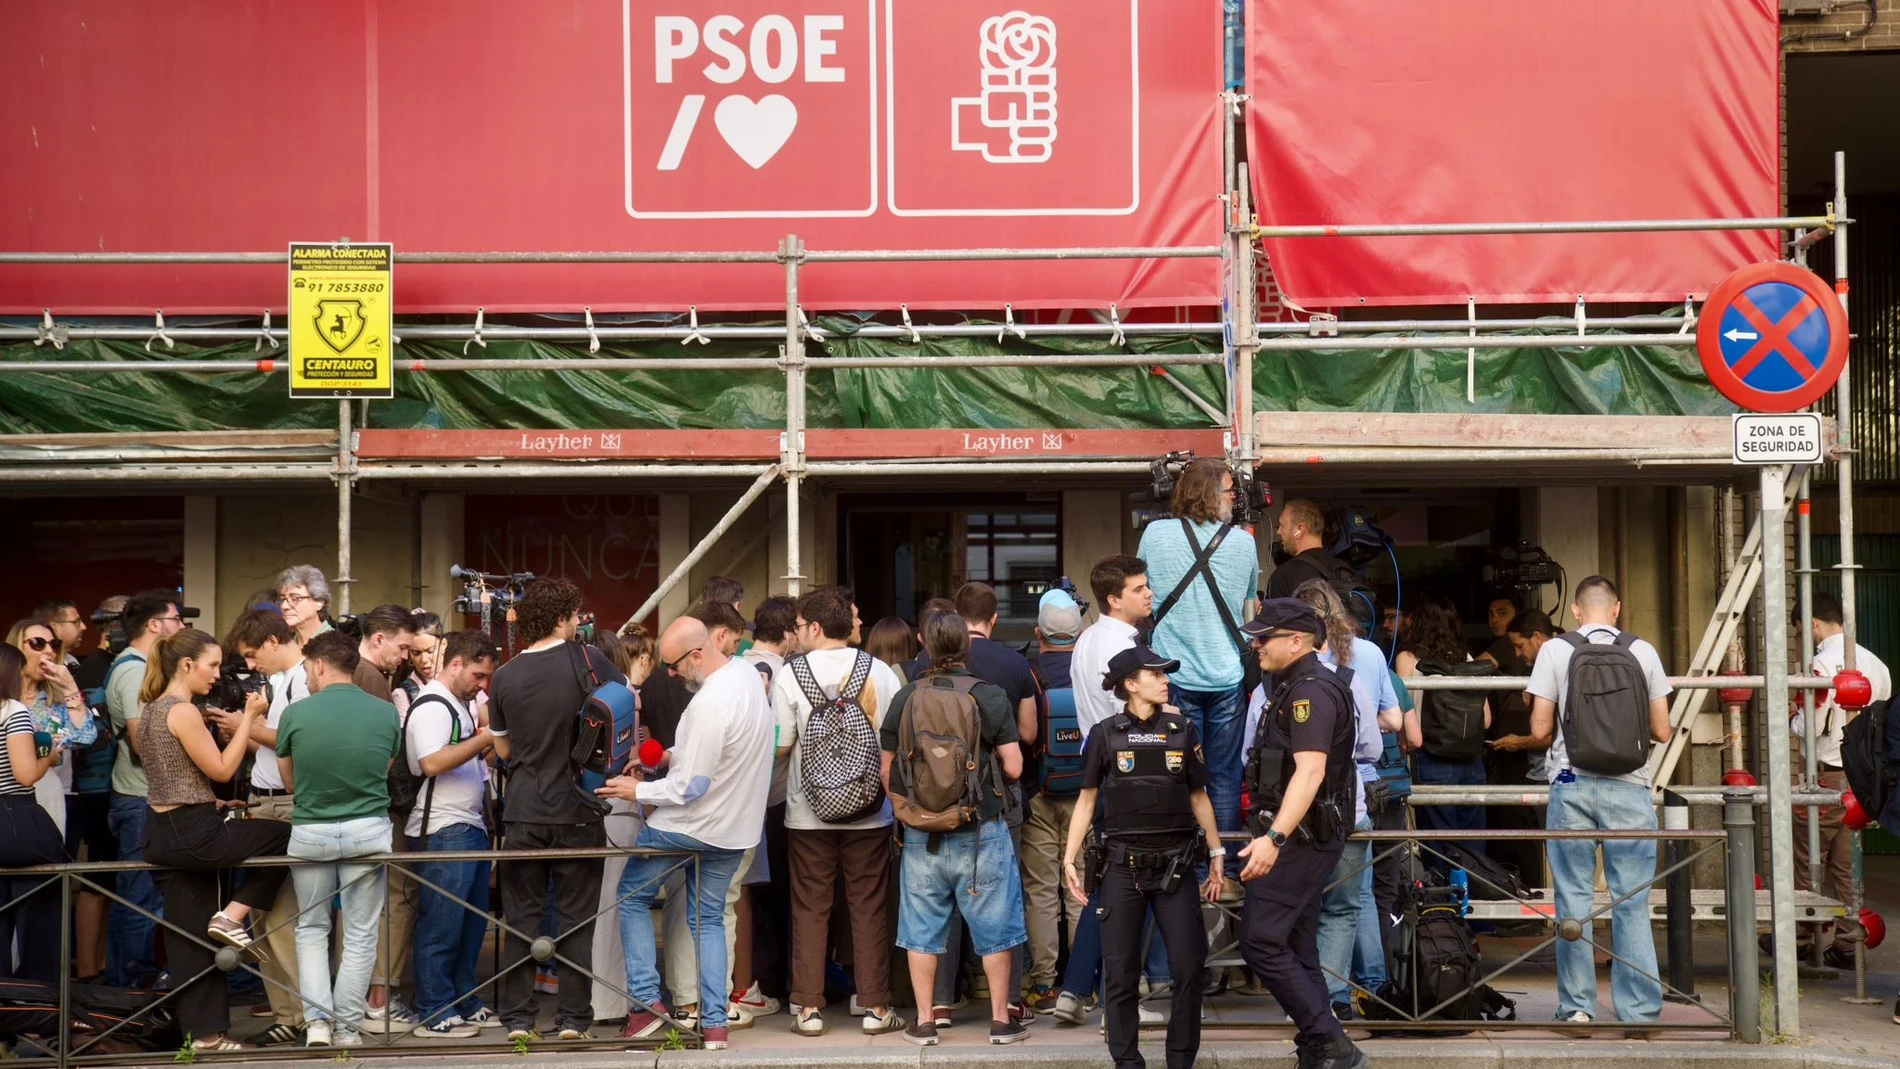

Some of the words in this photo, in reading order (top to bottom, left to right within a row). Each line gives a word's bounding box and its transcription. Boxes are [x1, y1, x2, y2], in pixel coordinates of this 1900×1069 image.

[654, 14, 846, 84] PSOE
[293, 249, 331, 258] ALARMA
[332, 249, 387, 258] CONECTADA
[308, 283, 323, 293] 91
[327, 283, 384, 293] 7853880
[306, 359, 374, 370] CENTAURO
[1749, 426, 1784, 437] ZONA
[1789, 425, 1806, 436] DE
[521, 433, 593, 453] Layher
[963, 433, 1034, 453] Layher
[1742, 441, 1814, 452] SEGURIDAD
[1056, 731, 1079, 741] LiveU
